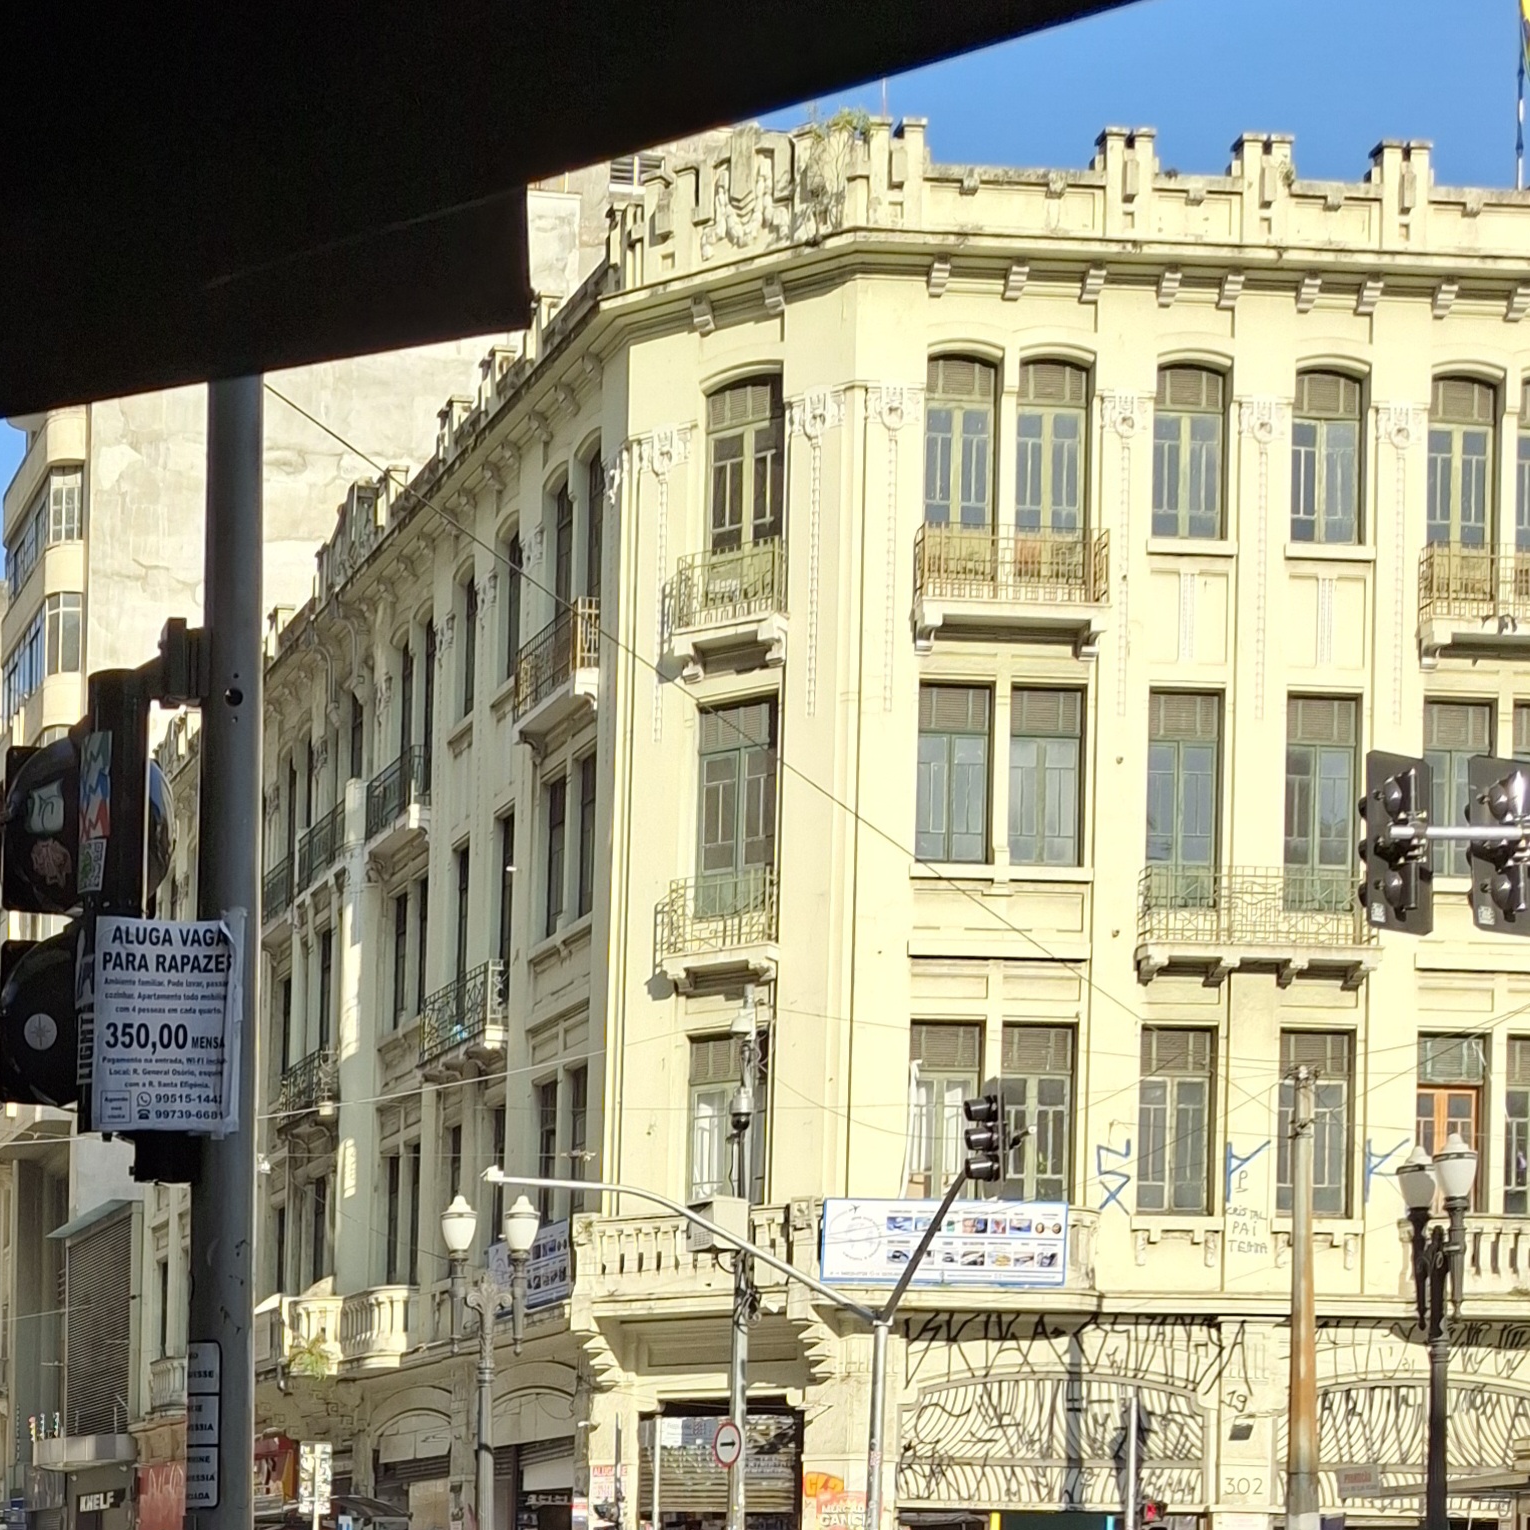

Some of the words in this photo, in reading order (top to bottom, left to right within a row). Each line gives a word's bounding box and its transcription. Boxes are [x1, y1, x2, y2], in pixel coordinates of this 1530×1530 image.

[111, 924, 173, 947] ALUGA
[102, 951, 150, 973] PARA
[105, 1022, 188, 1055] 350,00
[1224, 1477, 1263, 1496] 302
[79, 1490, 115, 1513] KHELF
